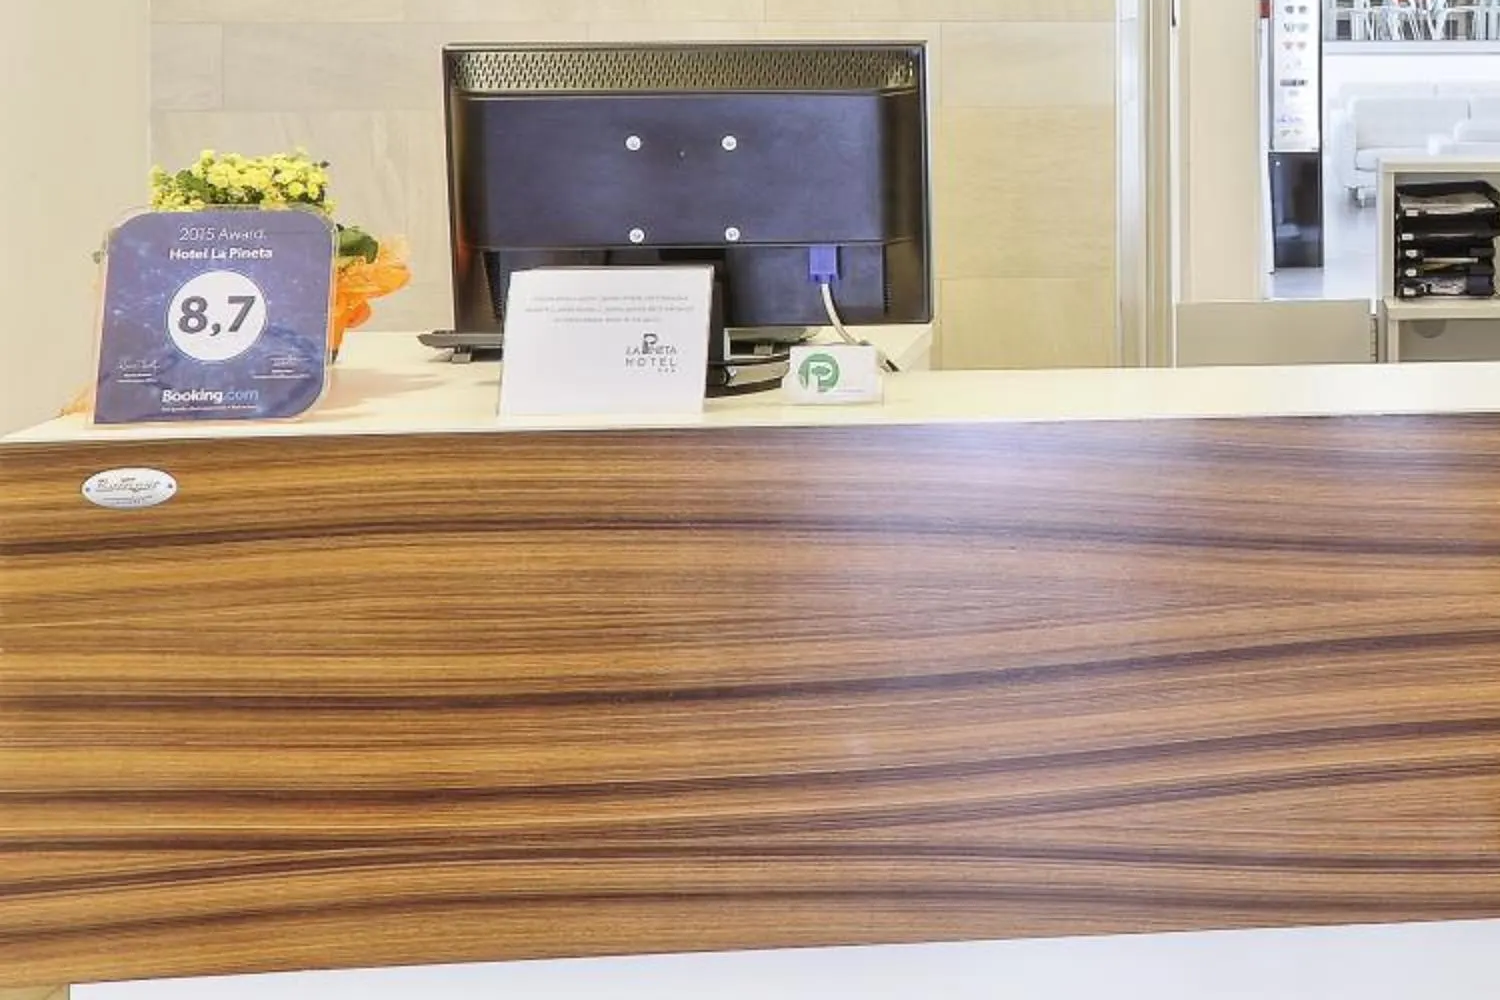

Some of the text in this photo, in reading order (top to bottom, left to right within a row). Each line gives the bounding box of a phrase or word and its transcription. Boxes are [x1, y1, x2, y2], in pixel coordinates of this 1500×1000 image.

[179, 227, 216, 241] 2015
[169, 247, 209, 260] Hotel
[228, 247, 274, 260] Pineta
[178, 295, 256, 336] 8,7
[625, 357, 677, 367] HOTEL
[161, 388, 259, 404] Booking.com
